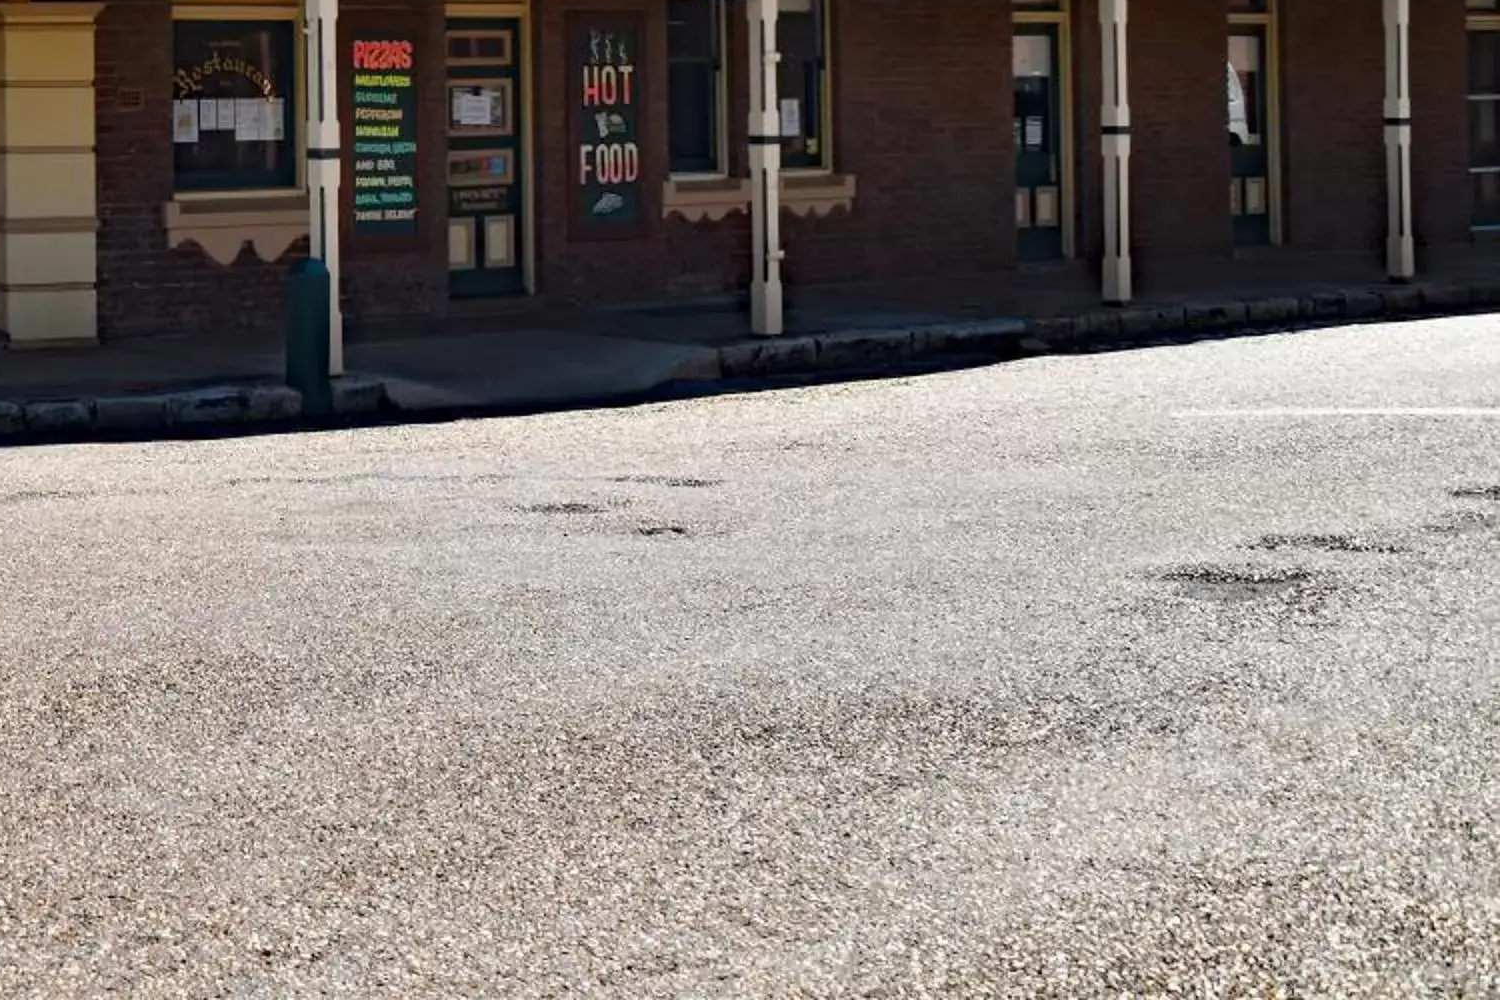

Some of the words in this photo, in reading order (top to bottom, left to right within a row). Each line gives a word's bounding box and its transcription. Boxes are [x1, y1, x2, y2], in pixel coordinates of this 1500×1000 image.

[353, 40, 414, 69] PIZZAS
[583, 65, 634, 106] HOT
[579, 142, 639, 185] FOOD
